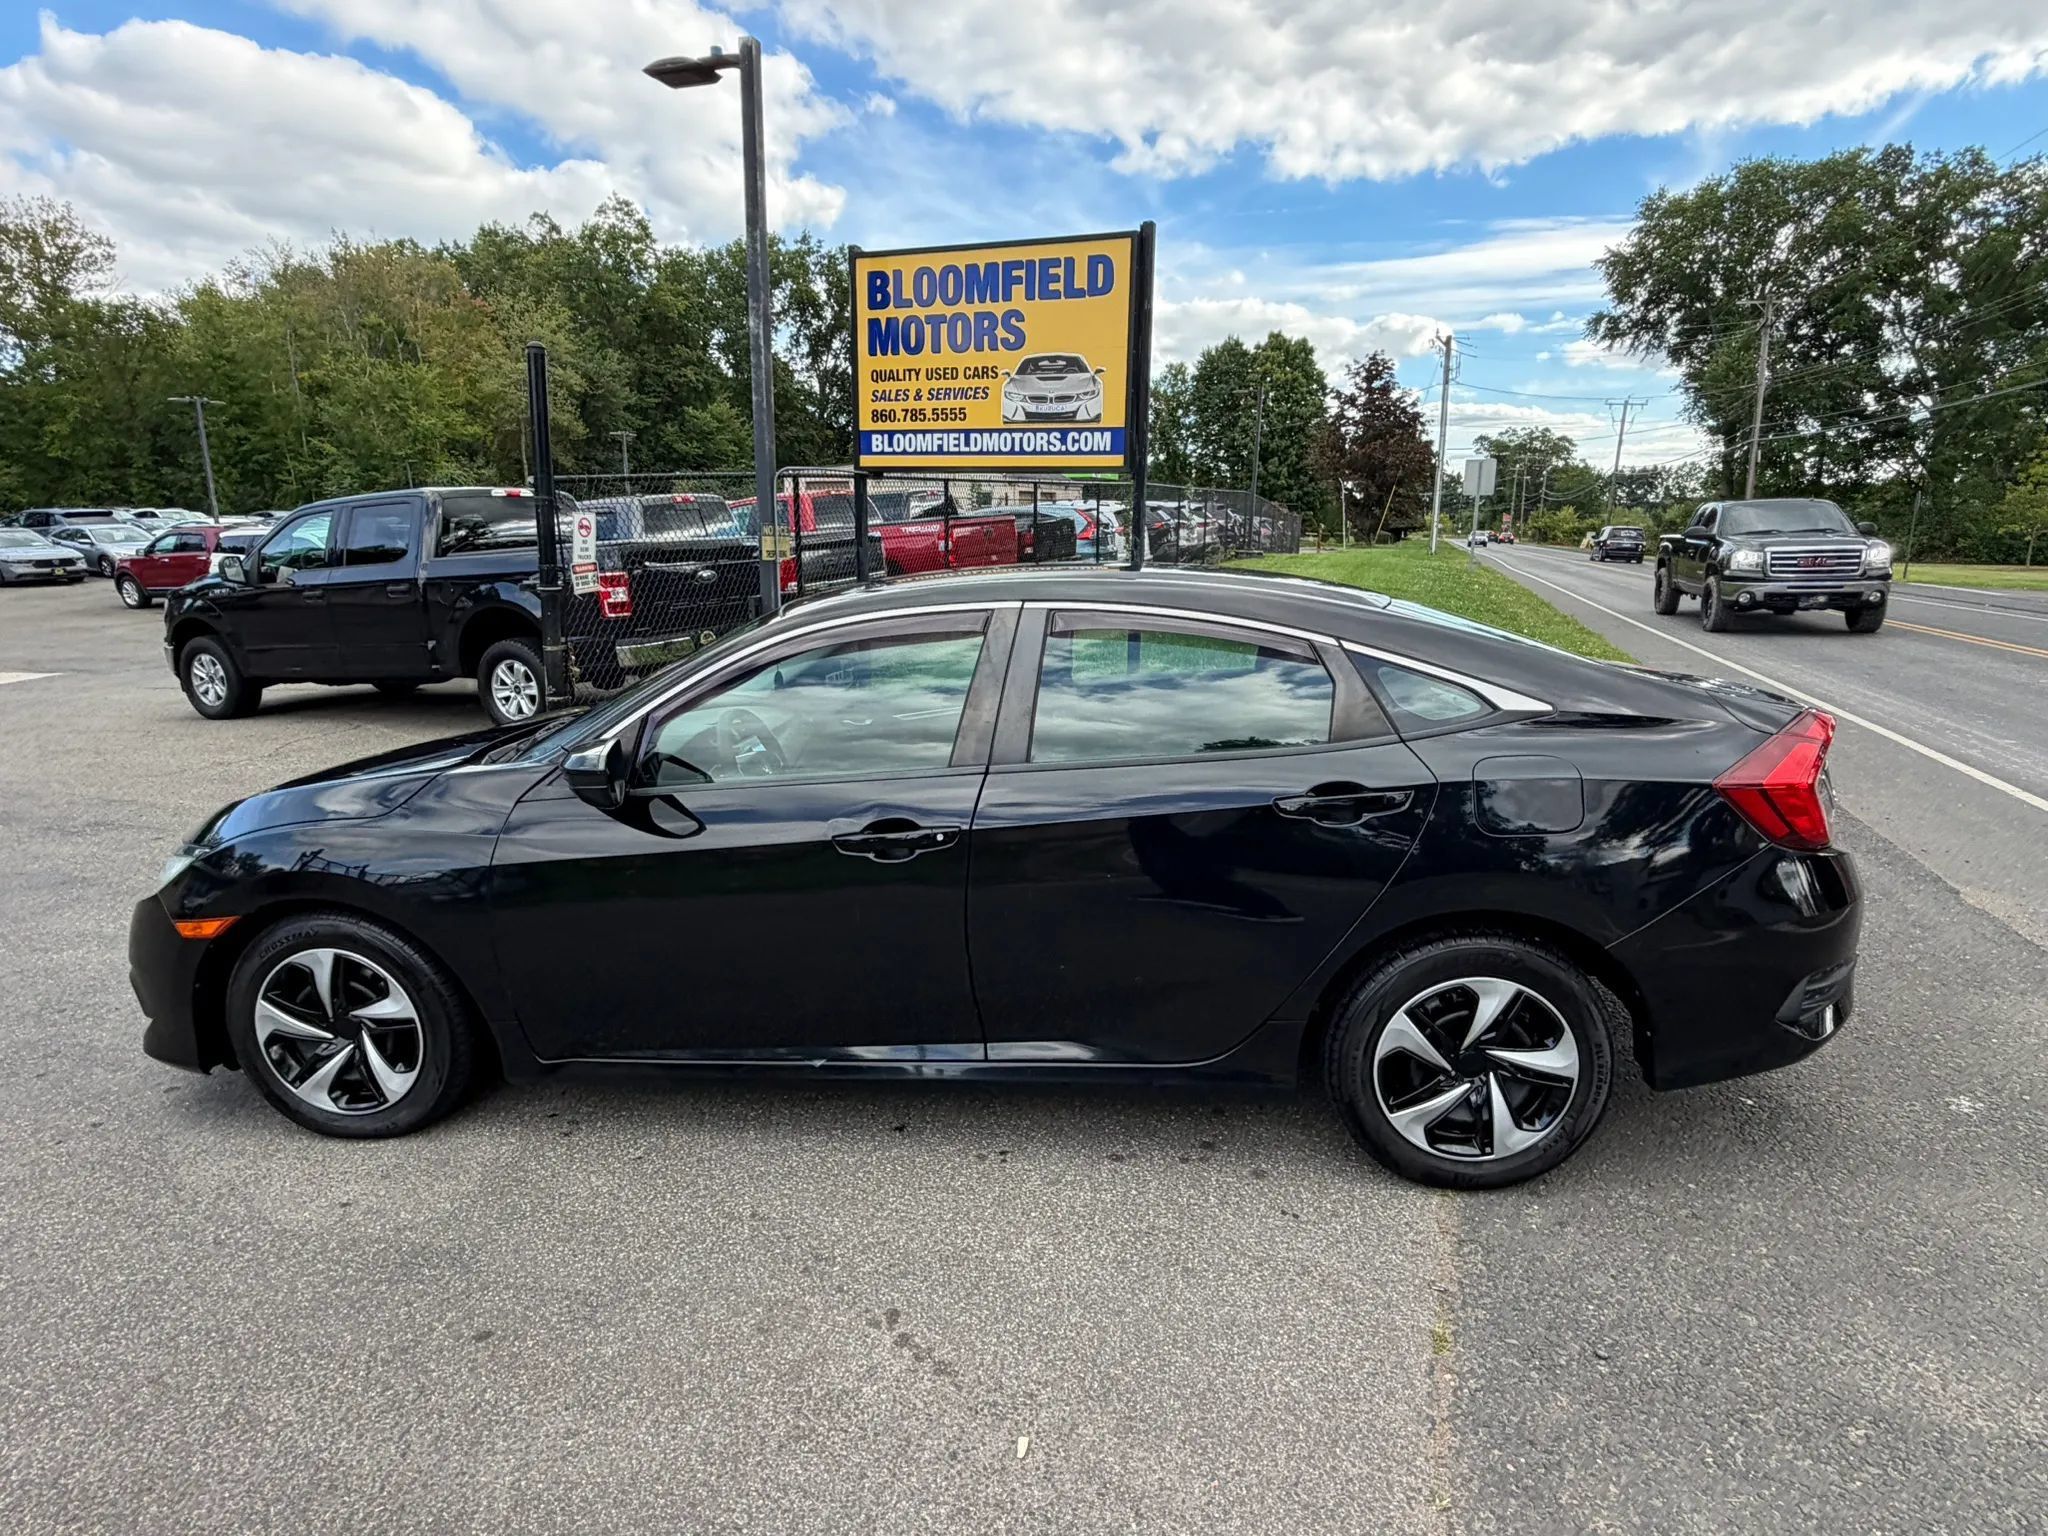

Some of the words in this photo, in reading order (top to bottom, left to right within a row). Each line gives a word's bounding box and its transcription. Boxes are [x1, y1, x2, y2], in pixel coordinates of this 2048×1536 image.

[867, 254, 1114, 310] BLOOMFIELD
[867, 309, 1026, 356] MOTORS
[871, 368, 921, 384] QUALITY
[925, 367, 959, 381] USED
[963, 365, 999, 380] CARS
[871, 389, 910, 403] SALES
[913, 388, 923, 402] &
[926, 386, 990, 401] SERVICES
[871, 407, 967, 423] 860.785.5555
[871, 431, 1112, 453] BLOOMFIELDMOTORS.COM
